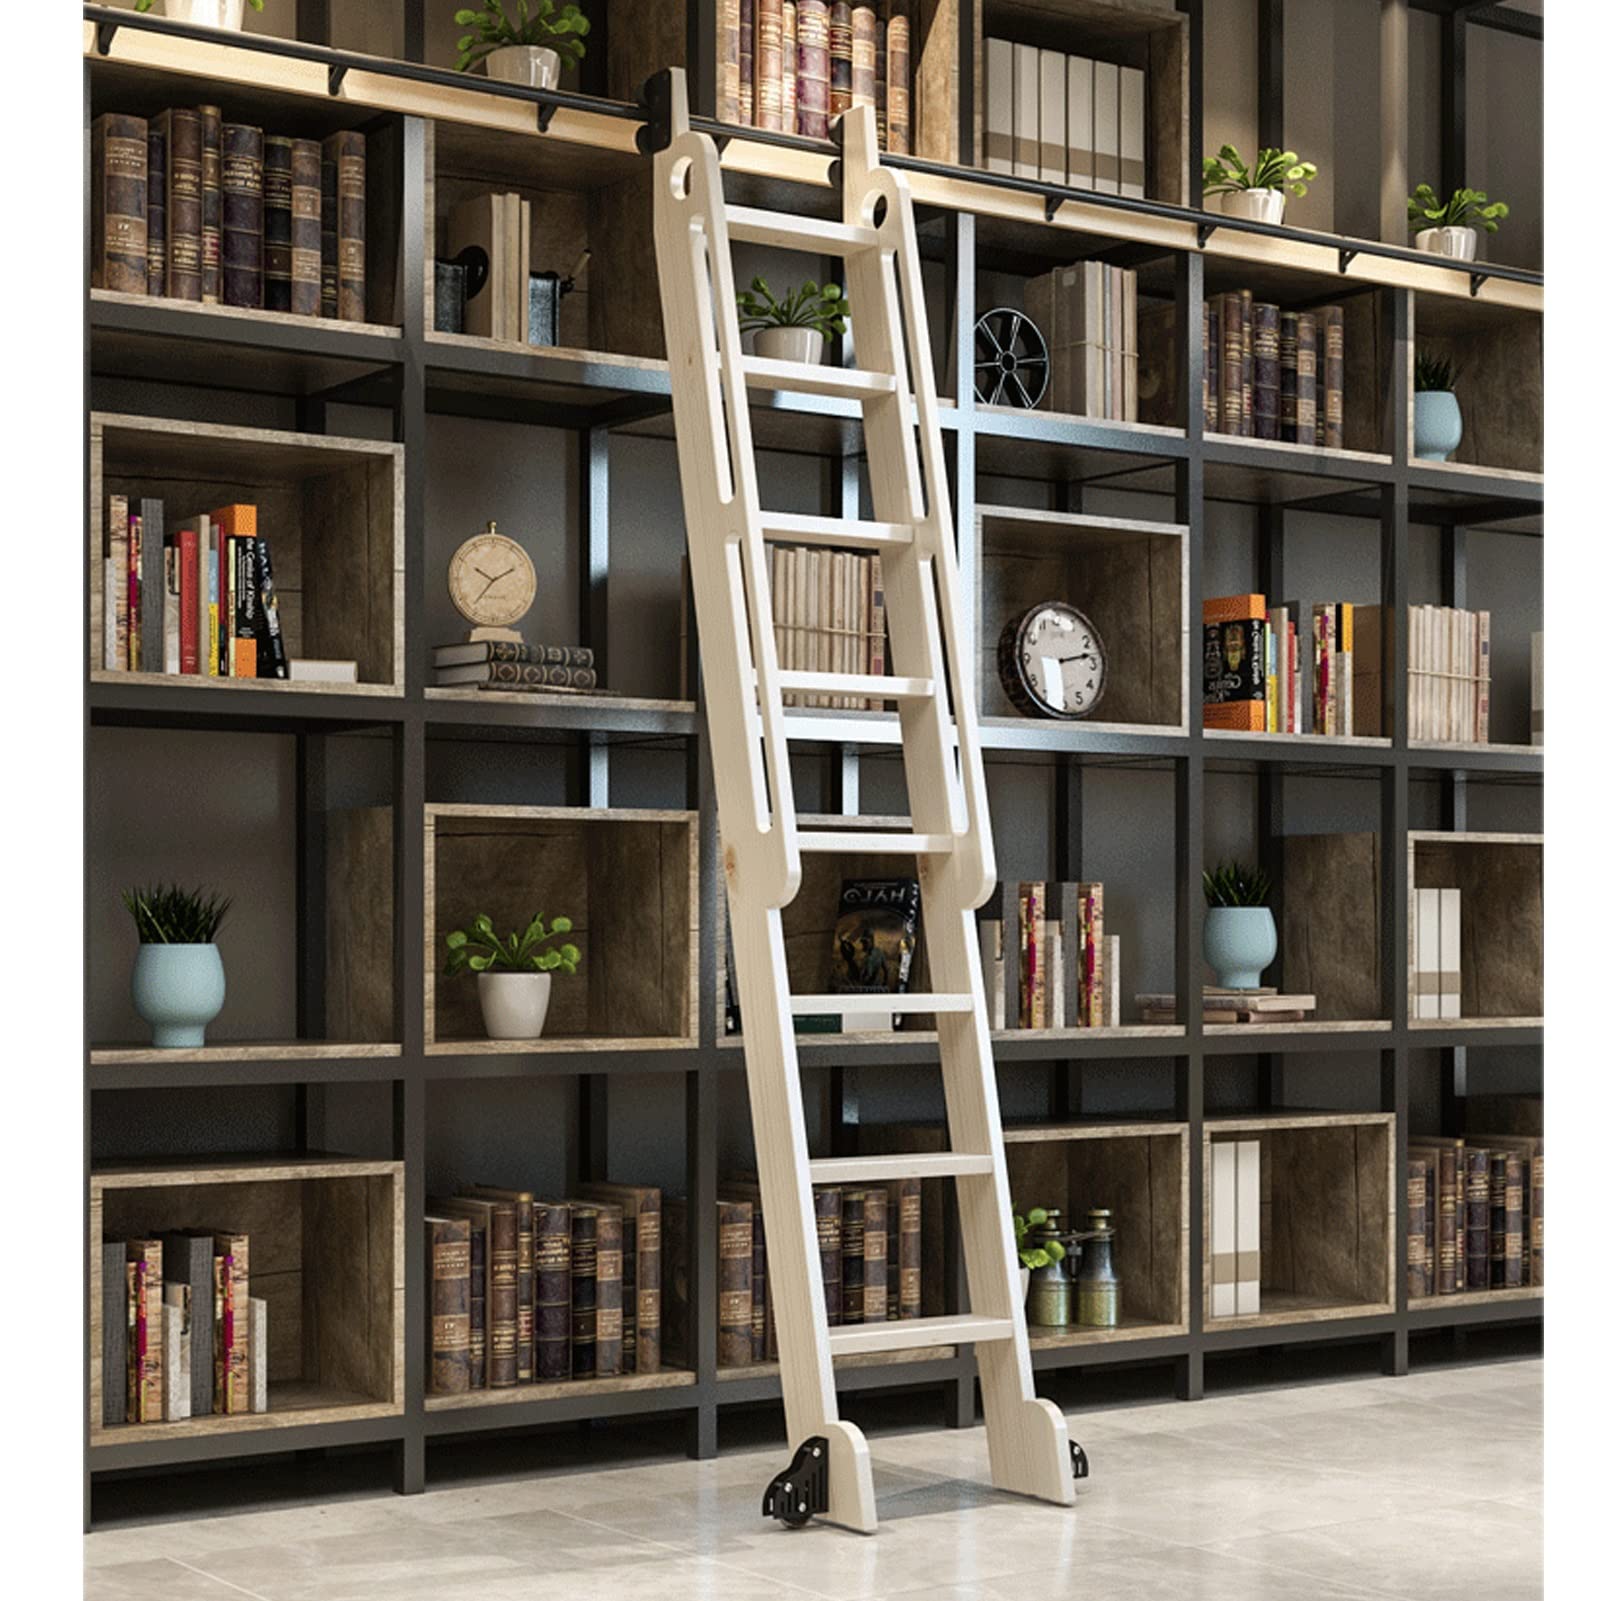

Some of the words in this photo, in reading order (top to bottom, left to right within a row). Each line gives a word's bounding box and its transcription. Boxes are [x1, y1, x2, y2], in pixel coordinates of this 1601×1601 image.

[246, 538, 255, 550] the
[246, 552, 255, 577] Genius
[246, 579, 255, 588] of
[1081, 635, 1090, 649] 2
[1023, 652, 1031, 665] 9
[1089, 657, 1098, 671] 3
[1086, 679, 1094, 690] 4
[1075, 691, 1083, 705] 5
